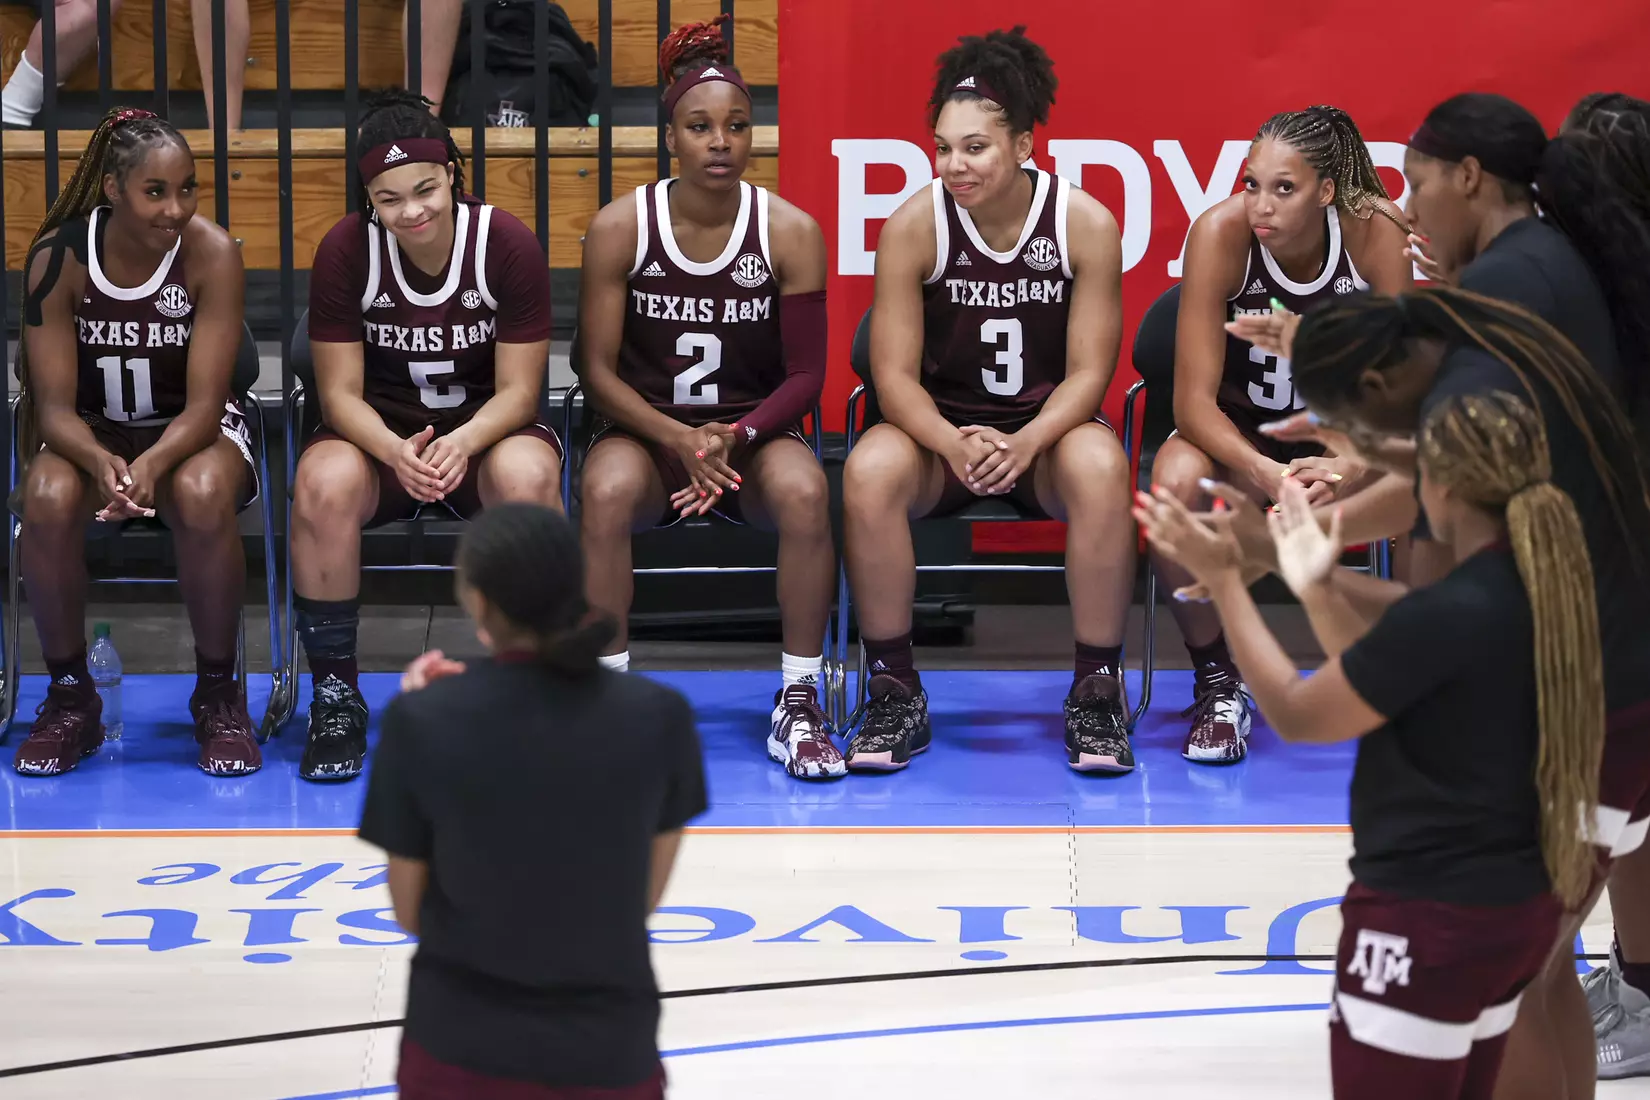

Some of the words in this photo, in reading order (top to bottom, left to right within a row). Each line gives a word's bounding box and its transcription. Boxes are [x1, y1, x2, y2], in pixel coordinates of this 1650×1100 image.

[384, 152, 408, 163] adidas
[831, 138, 1251, 277] BDY
[1025, 257, 1056, 271] GRADUATE
[1031, 239, 1054, 262] SEC
[733, 275, 766, 288] GRADUATE
[738, 255, 761, 279] SEC
[162, 286, 185, 310] SEC
[463, 292, 480, 308] SEC
[946, 279, 1016, 308] TEXAS
[1017, 278, 1064, 305] A&M
[1336, 279, 1352, 295] SEC
[157, 304, 189, 318] GRADUATE
[632, 289, 714, 323] TEXAS
[722, 296, 771, 323] A&M
[74, 315, 140, 347] EXAS
[146, 322, 191, 348] A&M
[363, 319, 444, 352] TEXAS
[452, 315, 496, 350] A&M
[673, 332, 722, 405] 2
[980, 318, 1024, 396] 3
[96, 356, 159, 422] 11
[1247, 345, 1306, 411] 3
[0, 888, 1597, 976] nivesity
